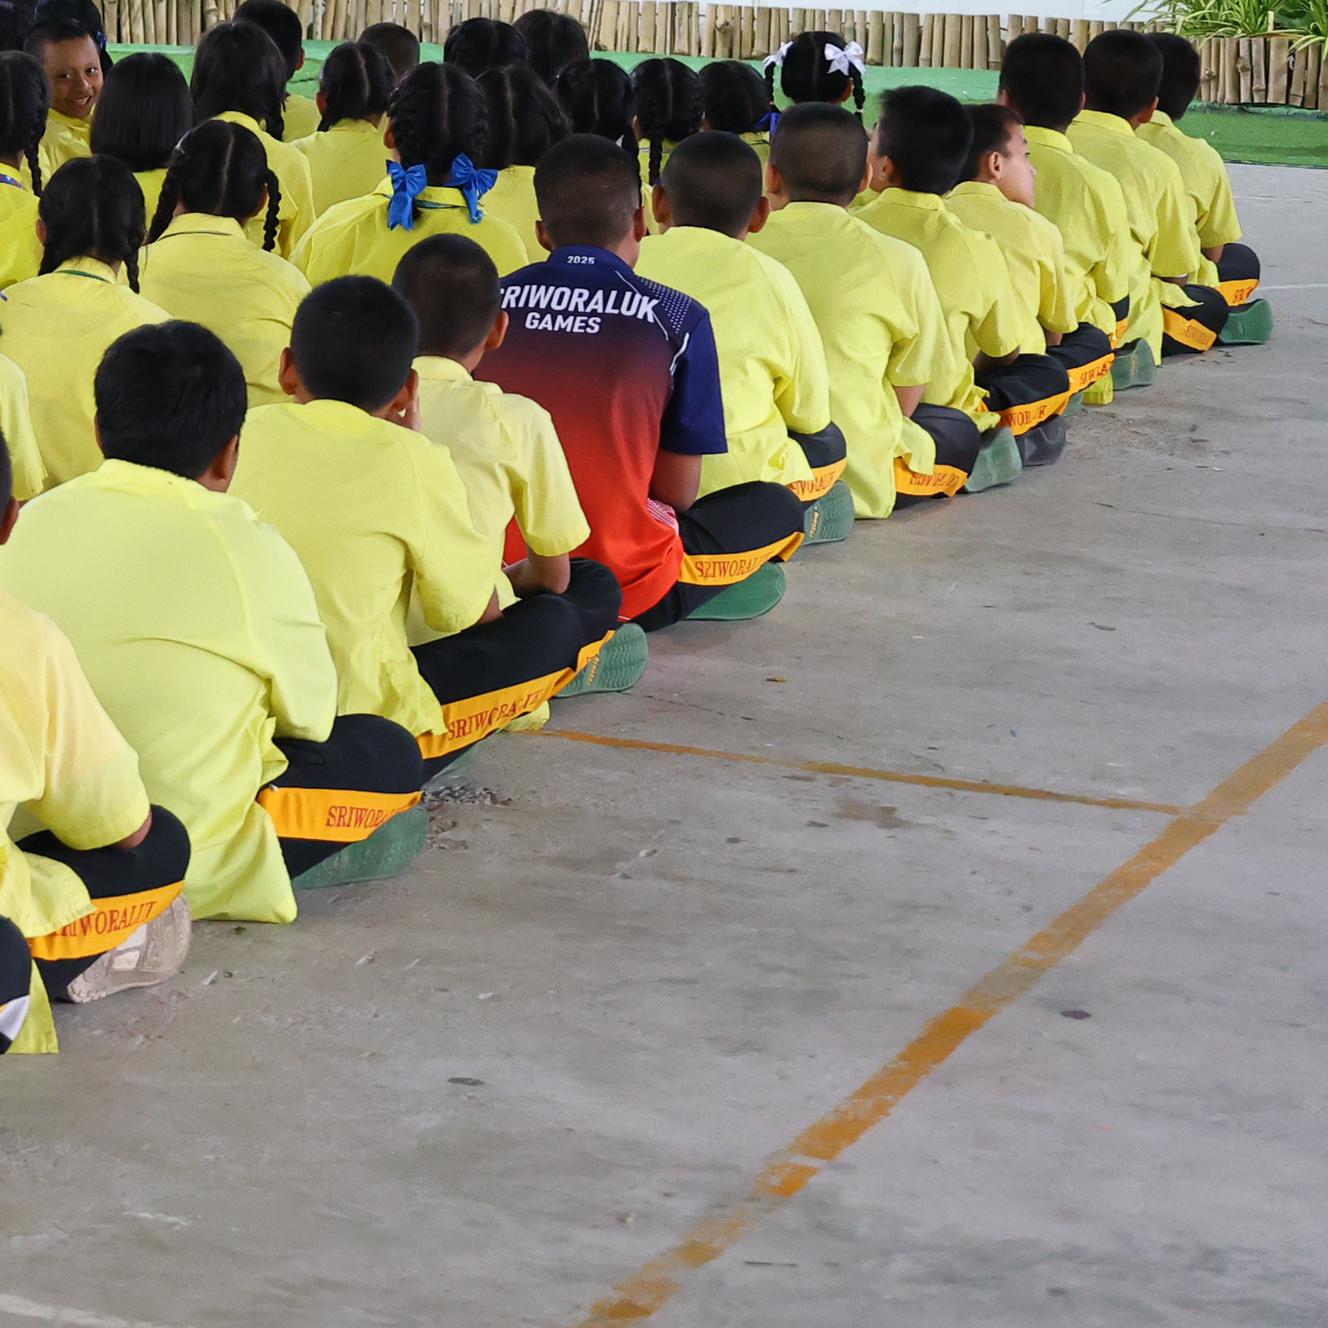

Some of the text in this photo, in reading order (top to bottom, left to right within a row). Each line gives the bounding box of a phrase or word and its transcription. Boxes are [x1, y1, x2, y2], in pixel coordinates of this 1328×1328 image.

[566, 255, 596, 265] 2025
[500, 284, 660, 323] RIWORALUK
[524, 312, 602, 334] GAMES
